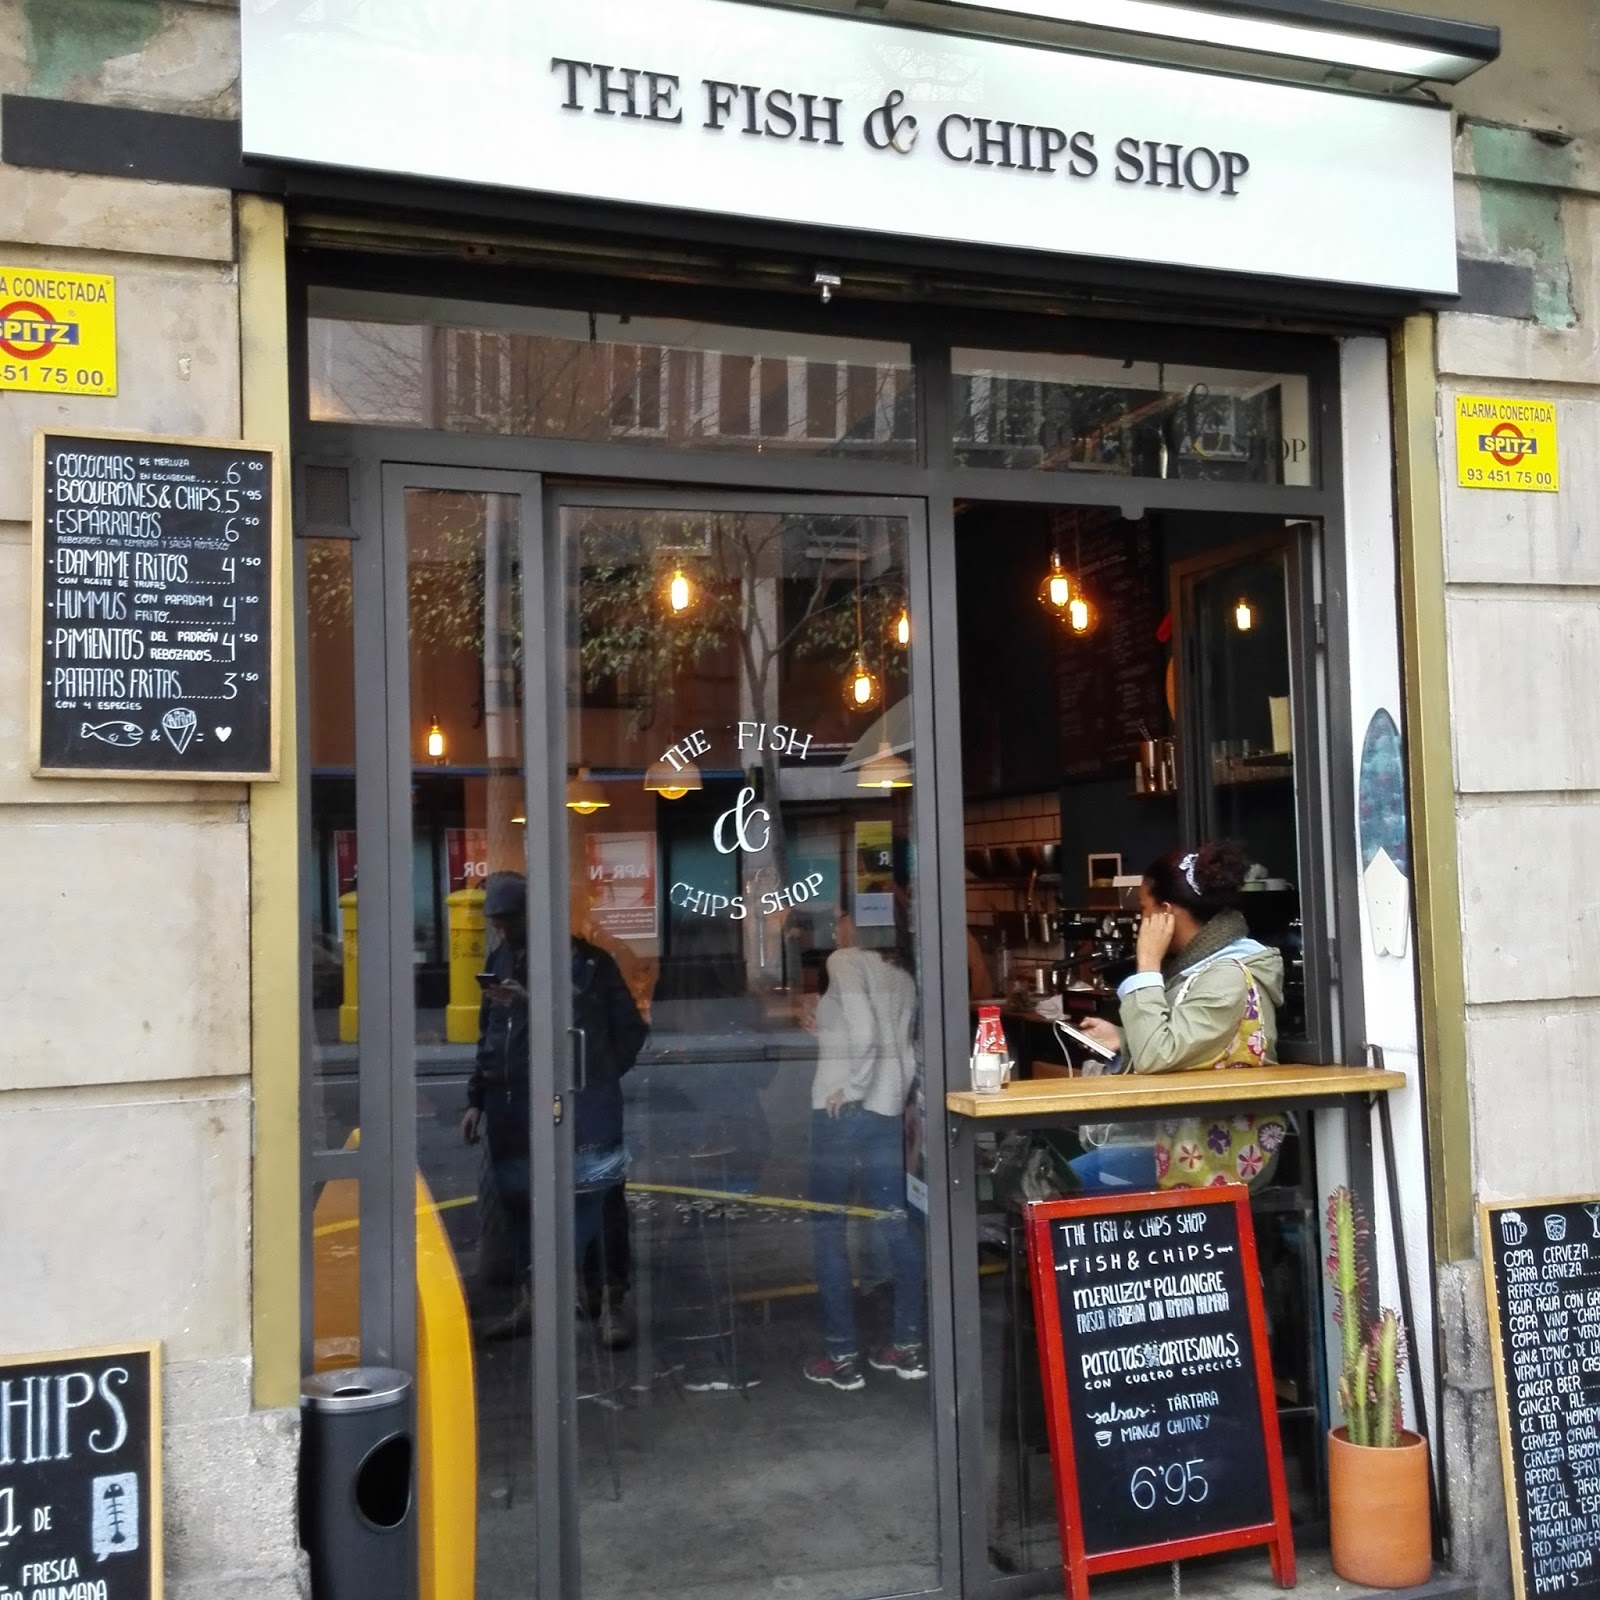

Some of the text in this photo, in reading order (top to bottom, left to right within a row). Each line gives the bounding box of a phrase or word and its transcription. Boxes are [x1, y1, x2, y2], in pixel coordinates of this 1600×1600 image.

[551, 57, 1250, 195] THE FISH & CHIPS SHOP
[13, 278, 108, 303] CONECTADA
[0, 365, 104, 386] 51 75 00
[1461, 403, 1552, 422] ALARMA CONECTADA
[1484, 437, 1532, 453] SPITZ
[56, 453, 136, 481] COCOCHAS
[139, 458, 150, 466] DE
[154, 458, 190, 467] MERLUZA
[1467, 469, 1551, 484] 93 451 75 00
[56, 506, 162, 539] ESPÁRRAGOS
[106, 538, 122, 546] CON
[169, 540, 193, 549] SALSA
[56, 548, 131, 579] EDAMAME
[57, 577, 78, 585] CON
[118, 580, 129, 588] DE
[134, 580, 166, 590] TRUFAS
[56, 589, 127, 620] HUMMUS
[134, 594, 158, 605] CON
[165, 595, 213, 607] PAPADAM
[150, 631, 168, 642] DEL
[178, 629, 218, 643] PADRÓN
[150, 648, 212, 662] REBOZADOS
[54, 667, 126, 698] PATATAS
[55, 701, 77, 709] CON
[83, 702, 92, 710] 4
[150, 729, 160, 742] &
[660, 721, 813, 772] THE FISH
[713, 787, 770, 854] &
[669, 873, 823, 920] CHIPS SHOP
[1060, 1223, 1086, 1247] THE
[1123, 1220, 1135, 1240] &
[1176, 1212, 1207, 1234] SHOP
[1128, 1250, 1140, 1270] &
[1504, 1243, 1588, 1267] COPA CERVEZA
[1506, 1262, 1582, 1283] JARRA CERVEZA
[1507, 1281, 1559, 1299] REFRESCOS
[1149, 1301, 1164, 1321] CON
[1536, 1295, 1560, 1312] AGUA
[1564, 1293, 1583, 1309] CON
[1509, 1315, 1538, 1332] COPA
[1512, 1333, 1540, 1348] COPA
[1514, 1362, 1551, 1382] VERMUT
[1554, 1360, 1565, 1376] DE
[1568, 1359, 1579, 1374] LA
[1085, 1379, 1111, 1390] CON
[1557, 1375, 1582, 1393] BEER
[1167, 1391, 1219, 1412] TÁRTARA
[1569, 1392, 1586, 1409] ALE
[0, 1367, 129, 1465] HIPS
[1538, 1413, 1557, 1430] TEA
[1121, 1414, 1211, 1443] MANGO CHUTNEY
[1521, 1425, 1598, 1451] CERVEZA ORVAL
[1523, 1447, 1565, 1469] CERVEZA
[1131, 1458, 1209, 1510] 6'95
[1525, 1467, 1562, 1486] APEROL
[1526, 1483, 1569, 1505] MEZCAL
[34, 1506, 53, 1532] DE
[1528, 1501, 1571, 1522] MEZCAL
[1530, 1517, 1587, 1541] MAGALLAN
[1531, 1530, 1600, 1558] RED SNAPPER
[22, 1557, 79, 1587] FRESCA
[1533, 1549, 1592, 1578] LIMONADA
